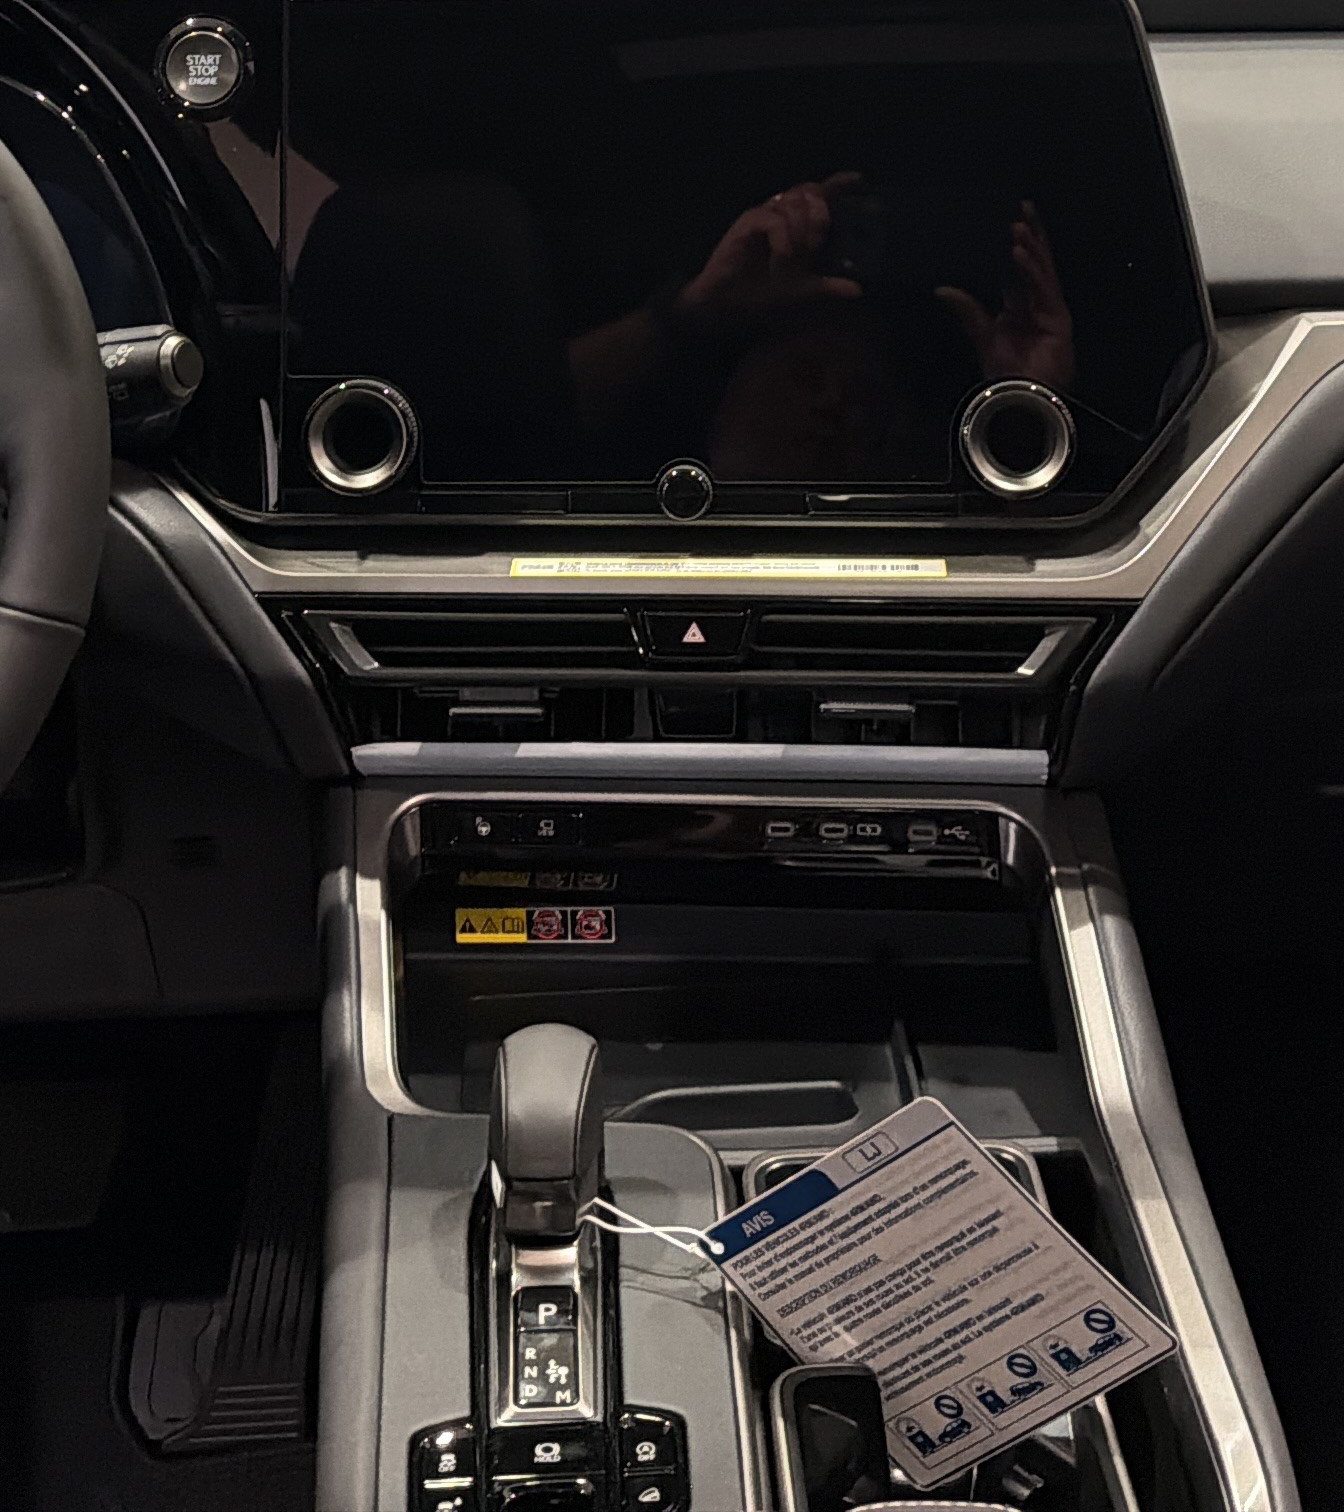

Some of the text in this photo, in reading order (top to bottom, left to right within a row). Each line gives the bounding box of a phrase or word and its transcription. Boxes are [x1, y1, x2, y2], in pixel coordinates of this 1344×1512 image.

[186, 54, 222, 66] START
[188, 66, 218, 77] STOP
[188, 77, 218, 86] ENGINE
[739, 1208, 774, 1238] AVIS
[538, 1303, 558, 1325] P
[525, 1347, 537, 1360] R
[523, 1365, 538, 1379] N
[524, 1384, 538, 1397] D
[556, 1389, 571, 1404] M
[533, 1455, 561, 1464] HOLD
